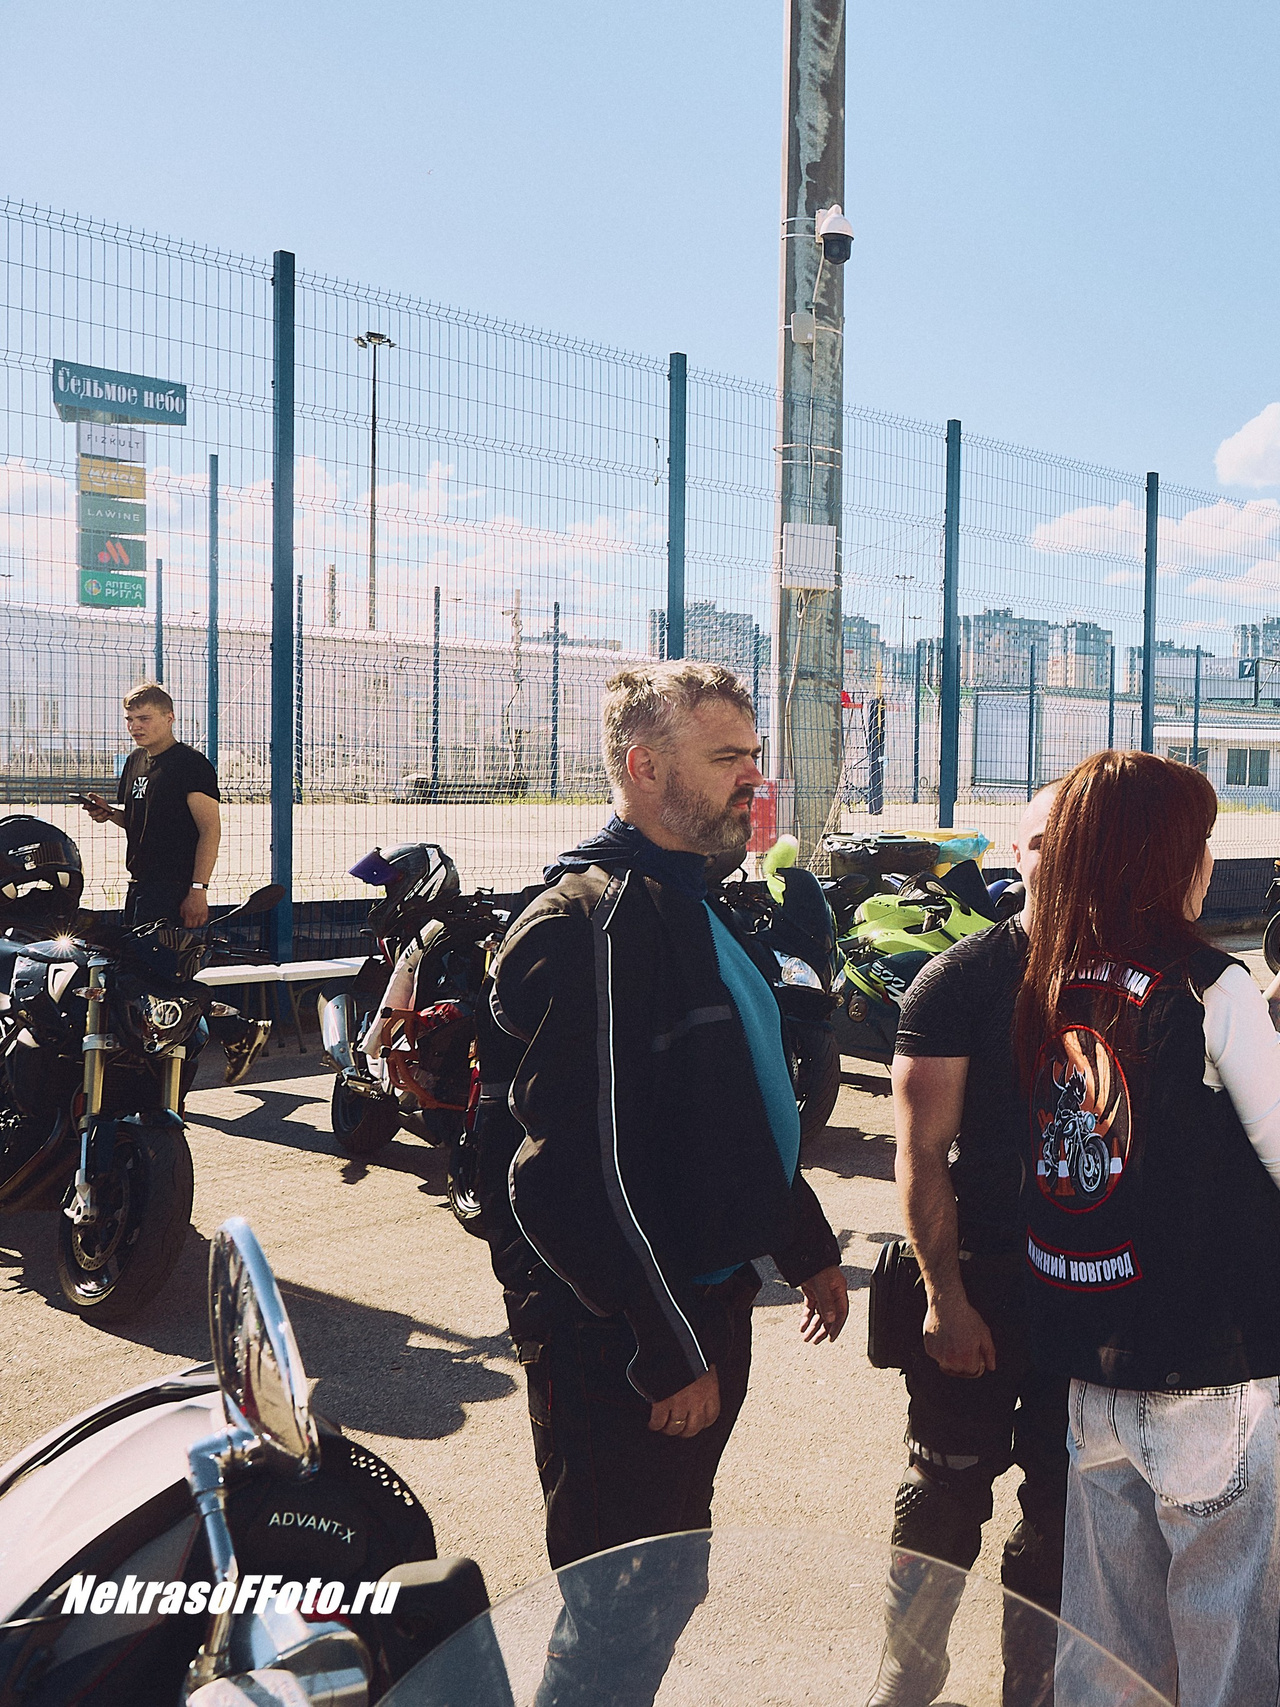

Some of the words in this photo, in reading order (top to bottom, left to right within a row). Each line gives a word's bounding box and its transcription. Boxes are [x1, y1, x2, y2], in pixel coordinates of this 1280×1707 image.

[58, 366, 138, 405] Седьмое
[143, 389, 185, 414] небо
[87, 433, 141, 449] FIZKULT
[87, 508, 140, 521] LAWINE
[105, 580, 142, 591] АПТЕКА
[1243, 662, 1252, 675] 7
[1028, 1236, 1066, 1280] НИЖНИЙ
[1070, 1251, 1134, 1283] НОВГОРОД
[268, 1511, 355, 1544] ADVANT-X
